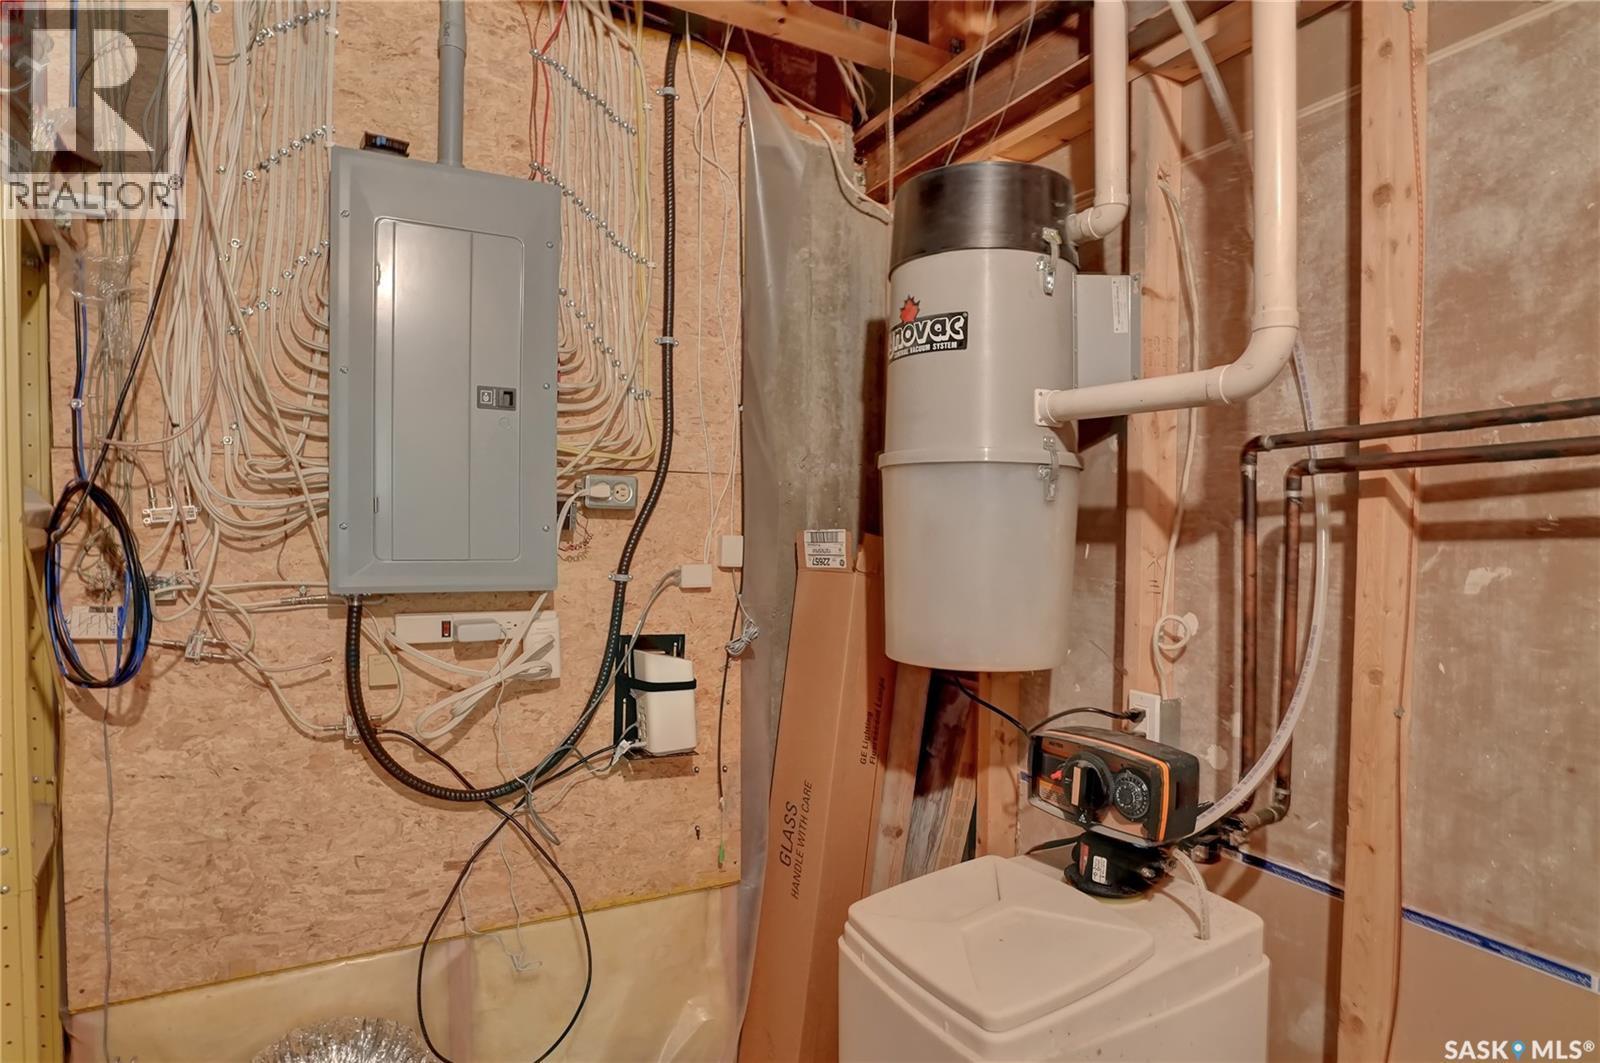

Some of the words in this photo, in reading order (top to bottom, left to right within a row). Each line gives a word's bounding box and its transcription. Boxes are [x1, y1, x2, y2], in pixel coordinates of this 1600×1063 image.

[932, 341, 958, 350] SYSTEM
[812, 558, 830, 566] 22657
[862, 711, 874, 750] Lighting
[860, 752, 868, 765] GE
[802, 779, 813, 813] CARE
[780, 801, 798, 867] GLASS
[797, 815, 808, 848] WITH
[790, 848, 804, 900] HANDLE
